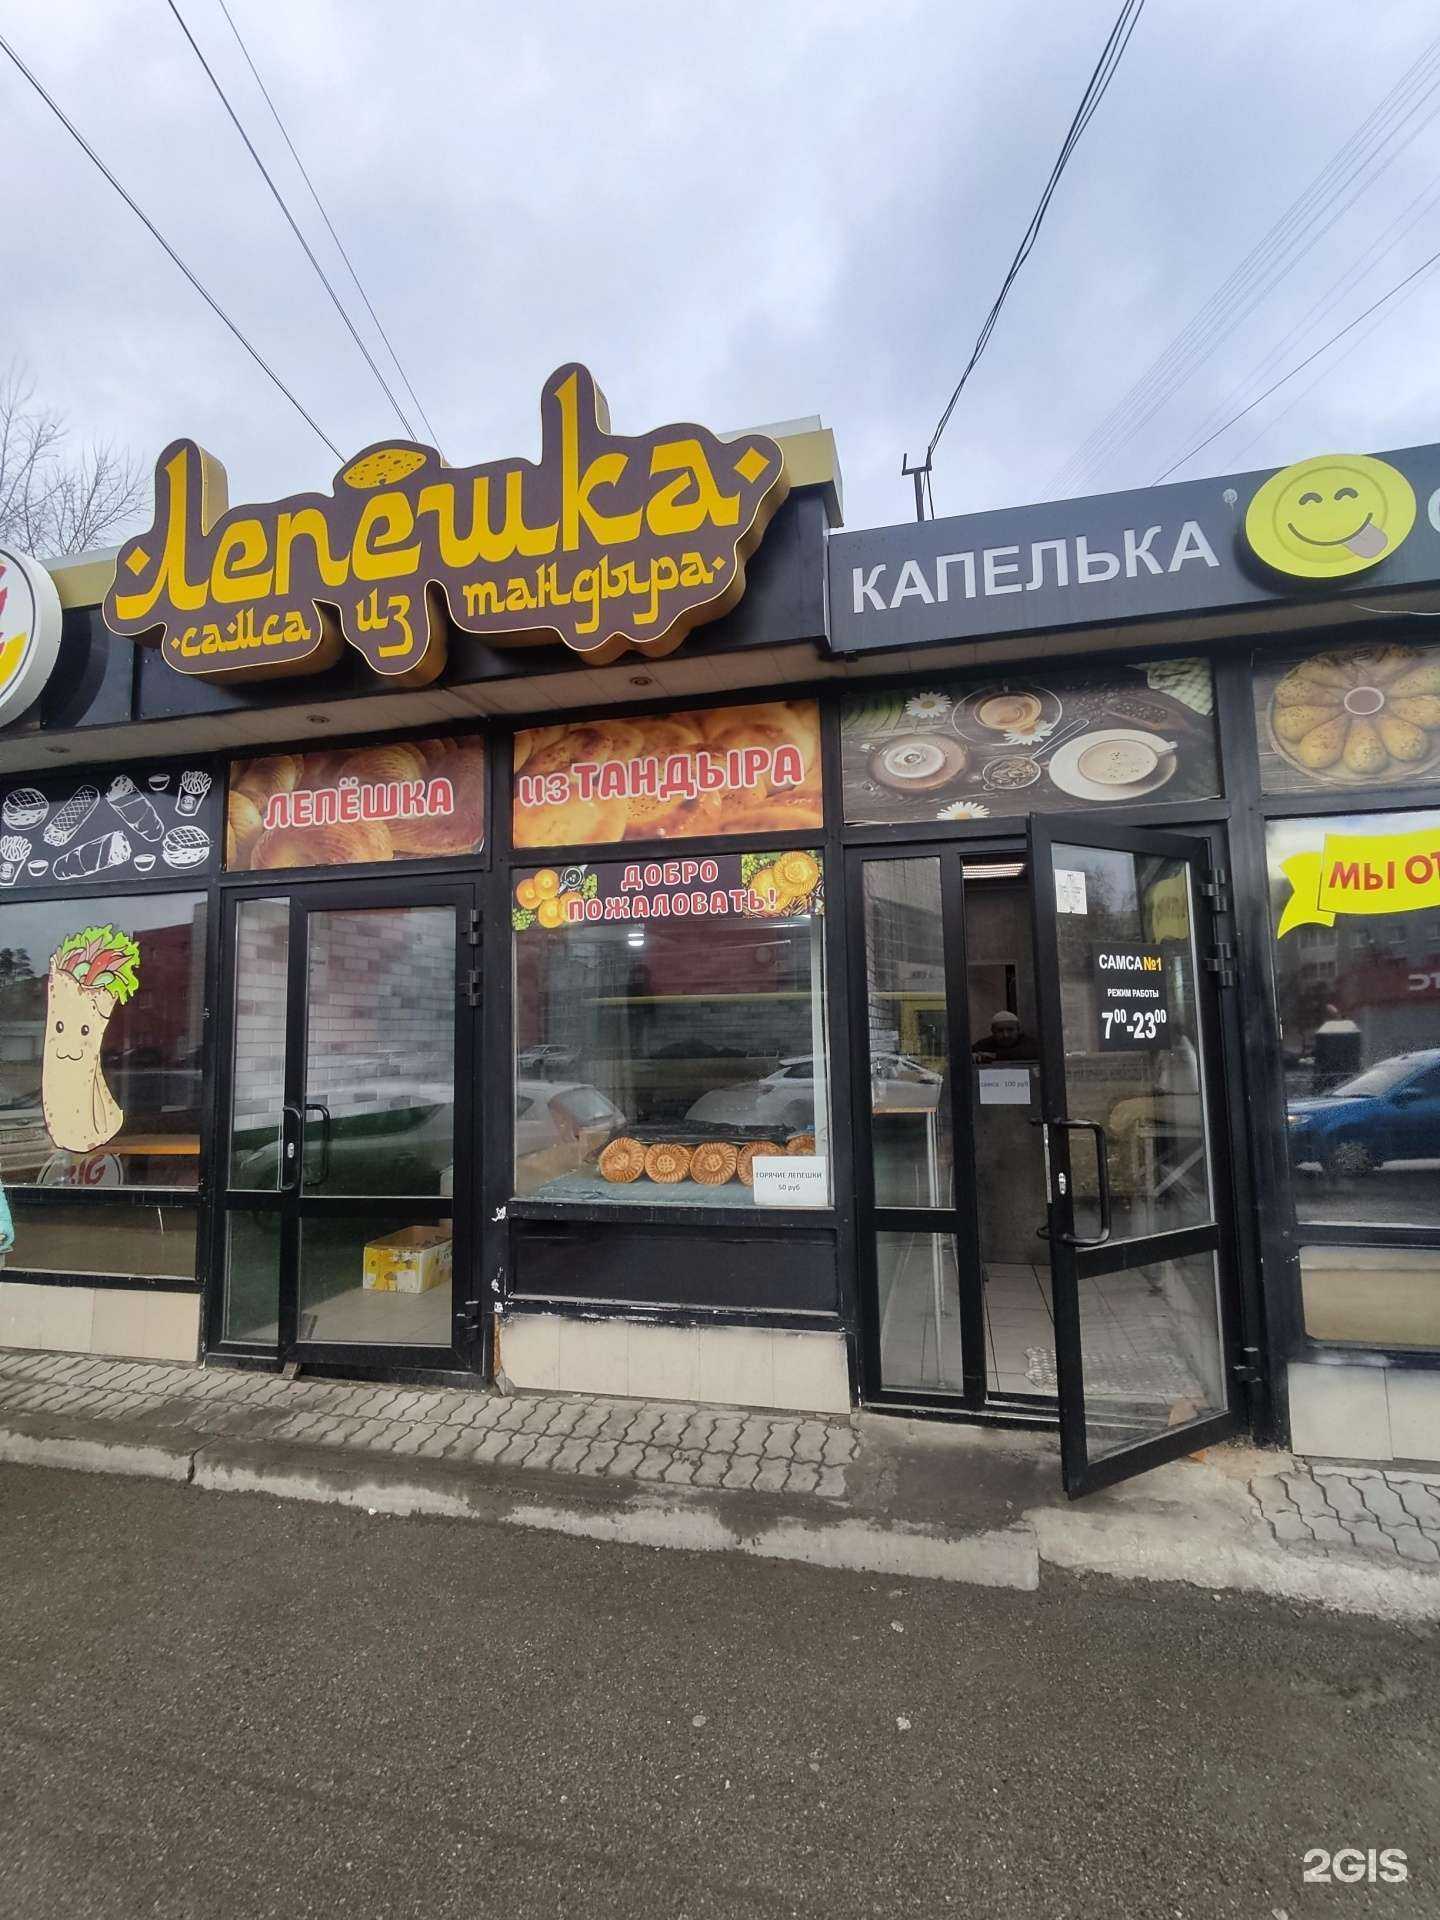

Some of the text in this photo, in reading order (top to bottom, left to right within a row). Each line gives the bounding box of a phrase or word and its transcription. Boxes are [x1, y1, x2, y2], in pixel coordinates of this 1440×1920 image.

[851, 519, 1220, 614] КАПЕЛЬКА
[356, 588, 414, 658] из
[463, 551, 714, 634] тандыра
[571, 744, 805, 800] ТАНДЫРА
[264, 777, 455, 829] ЛЕПЁШКА
[620, 859, 719, 891] ДОБРО
[1328, 860, 1396, 891] МЫ
[567, 888, 778, 922] ПОЖАЛОВАТЬ!
[1098, 953, 1143, 971] САМСА
[1107, 988, 1160, 998] РЕЖИМ РАБОТЫ
[755, 1171, 786, 1180] ГОРЯЧИЕ
